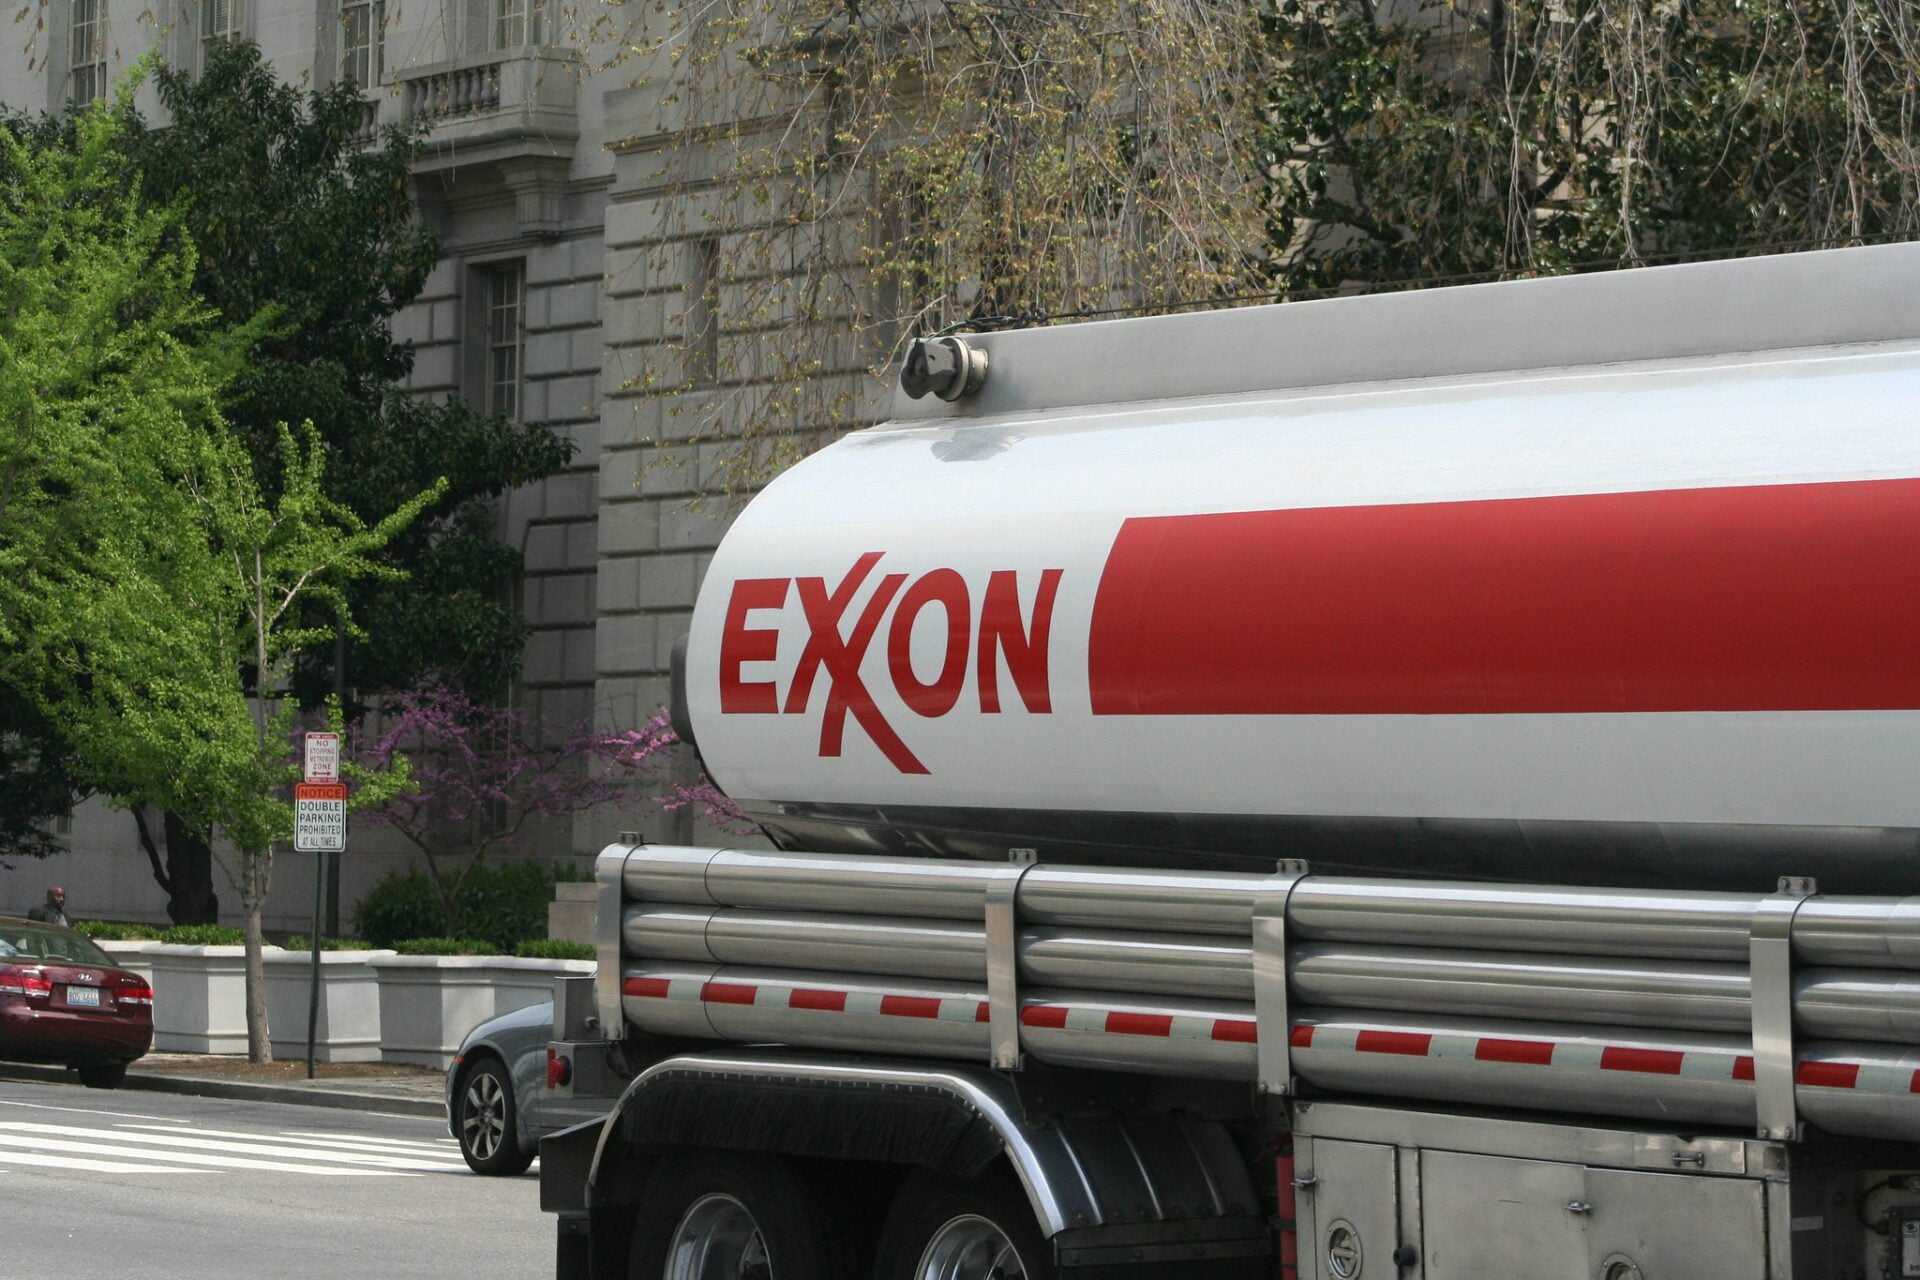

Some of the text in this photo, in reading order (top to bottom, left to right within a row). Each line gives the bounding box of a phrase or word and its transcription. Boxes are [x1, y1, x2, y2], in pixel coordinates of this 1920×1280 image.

[719, 551, 1064, 775] EXXON
[301, 788, 341, 798] NOTICE
[300, 801, 341, 811] DOUBLE
[299, 813, 341, 823] PARKING
[299, 825, 341, 834] PROHIBITED
[302, 837, 336, 847] AT ALL TIMES
